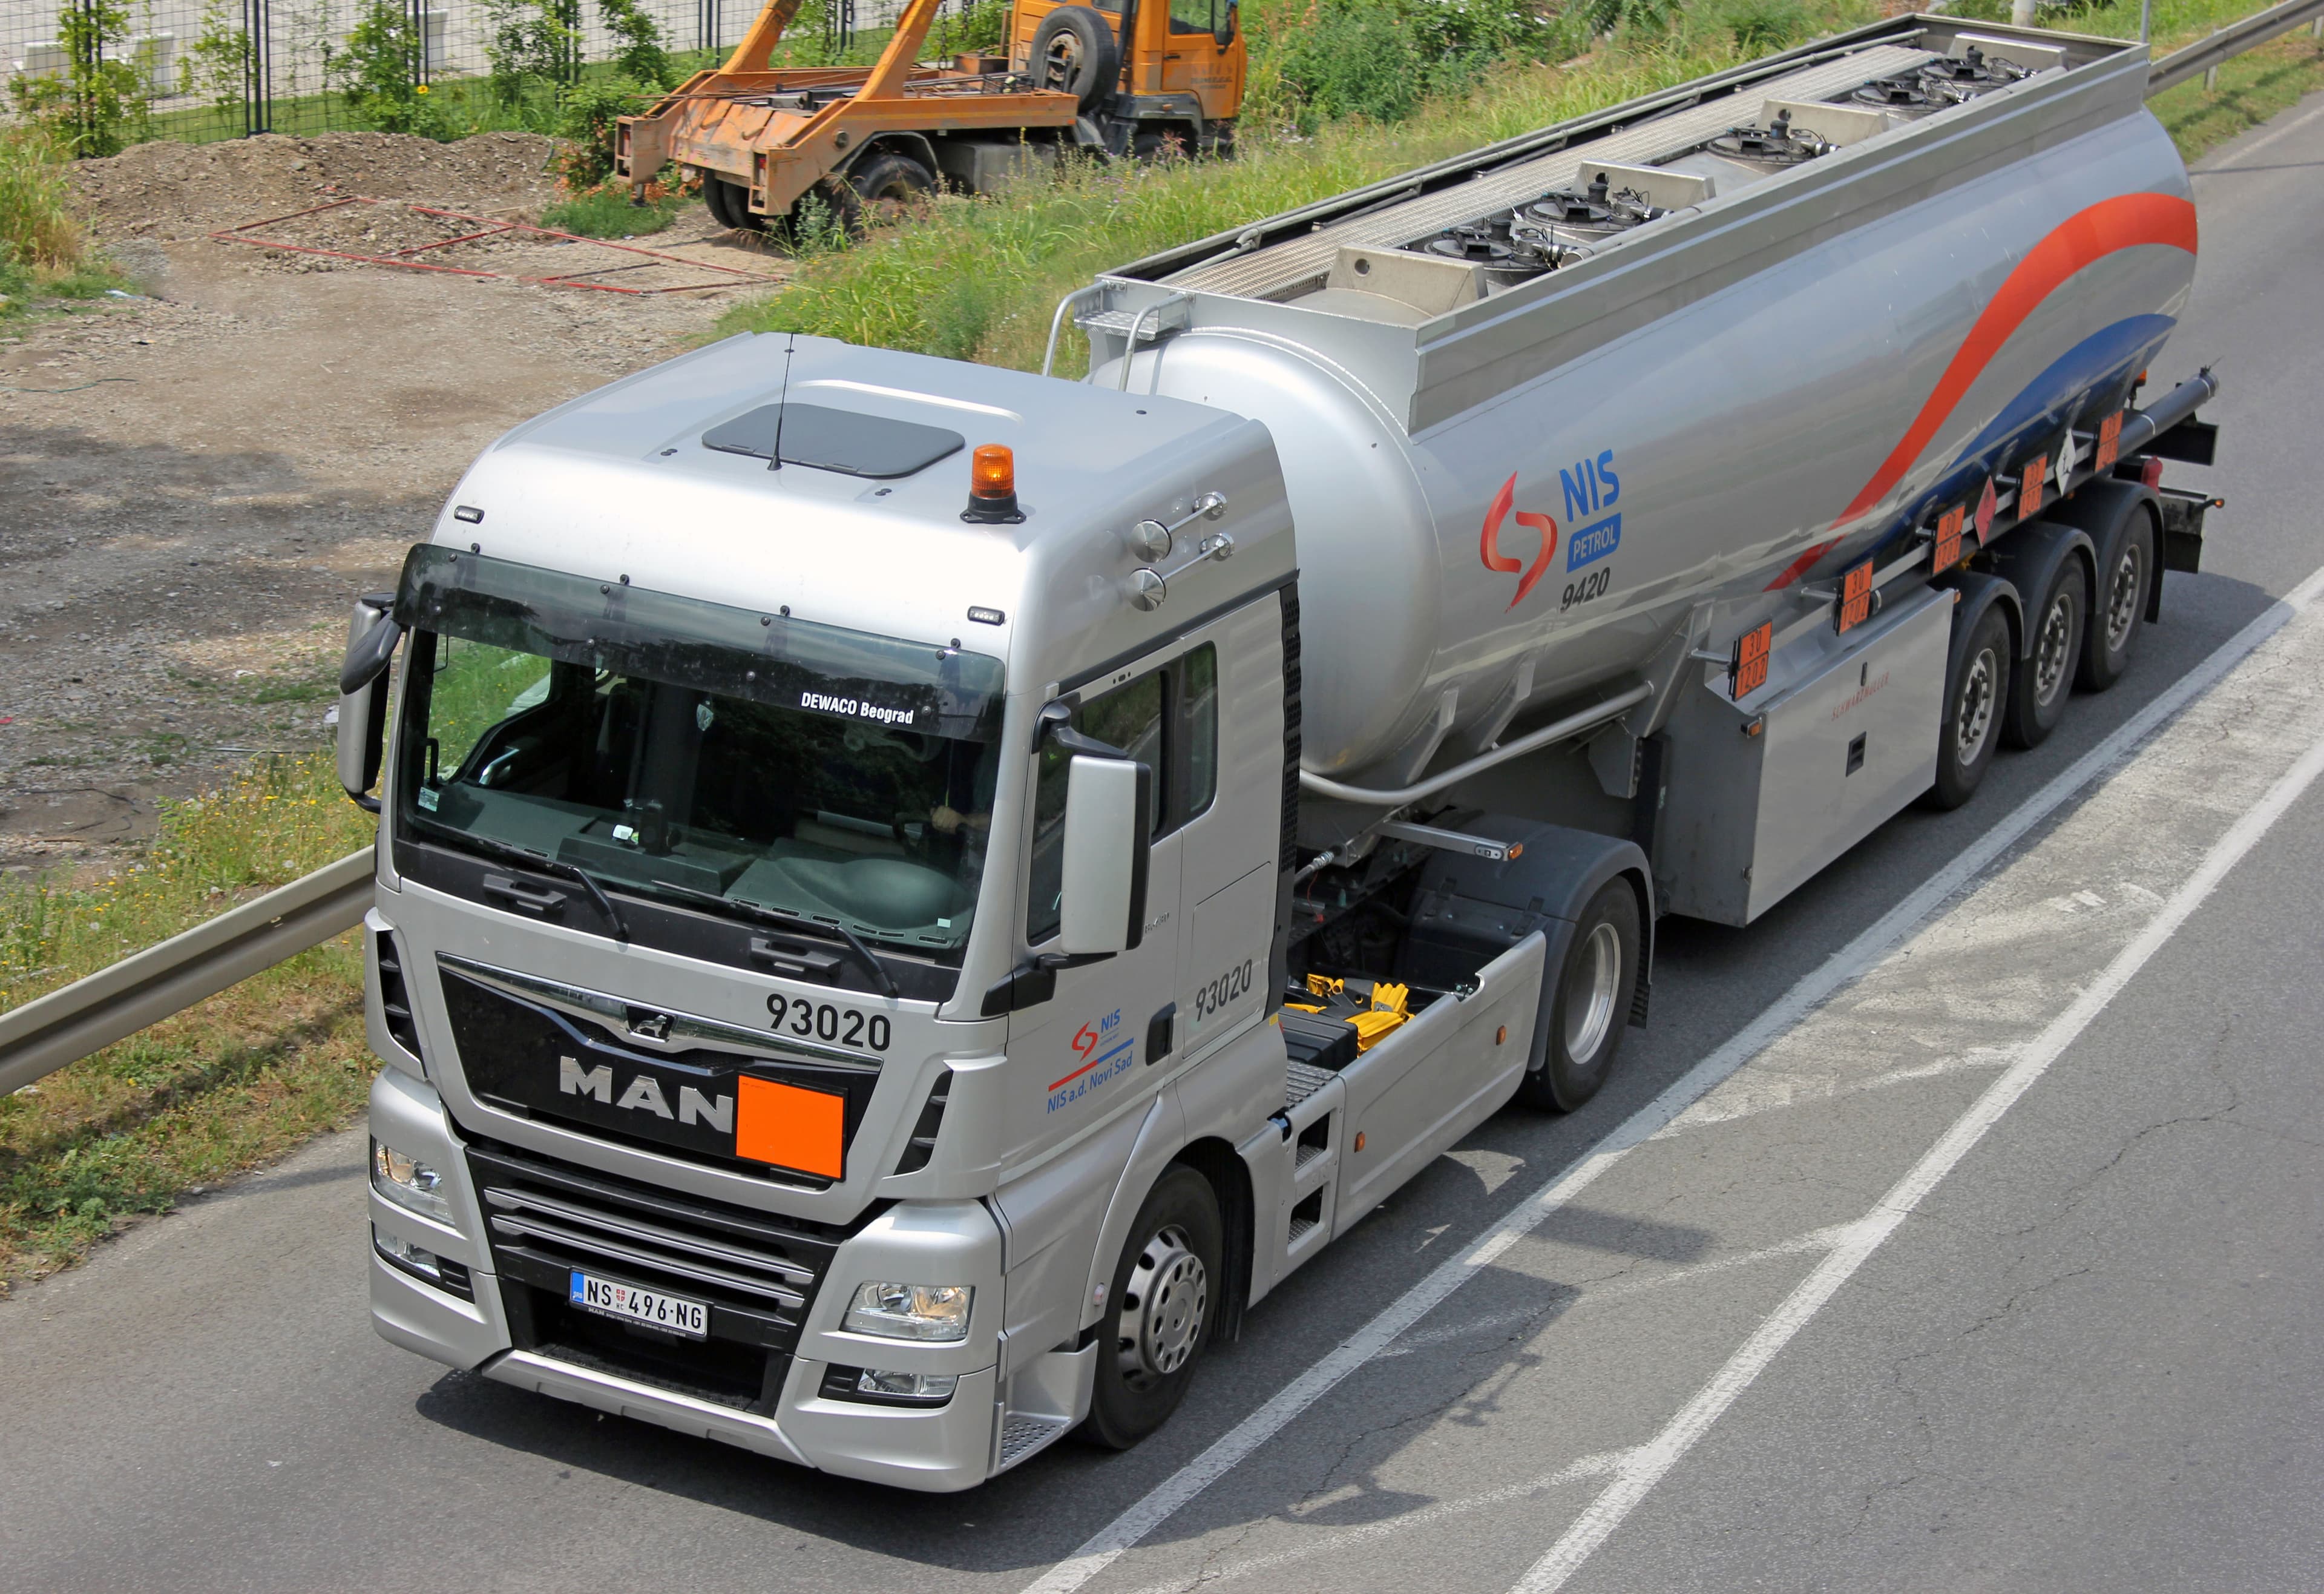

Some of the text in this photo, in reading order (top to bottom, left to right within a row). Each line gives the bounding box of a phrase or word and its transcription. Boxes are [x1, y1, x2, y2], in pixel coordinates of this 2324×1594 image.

[1559, 449, 1620, 522] NIS
[1573, 525, 1615, 562] PETROL
[1560, 567, 1610, 614] 9420
[1853, 568, 1864, 594] 30
[1749, 630, 1762, 657] 30
[1739, 657, 1766, 693] 1202
[801, 692, 914, 725] DEWACO Beograd
[1195, 959, 1253, 1023] 93020
[766, 993, 891, 1052] 93020
[1100, 1008, 1121, 1033] NIS
[560, 1056, 734, 1134] MAN
[1047, 1051, 1133, 1114] NIS a.d. Novi Sad
[588, 1280, 611, 1306] NS
